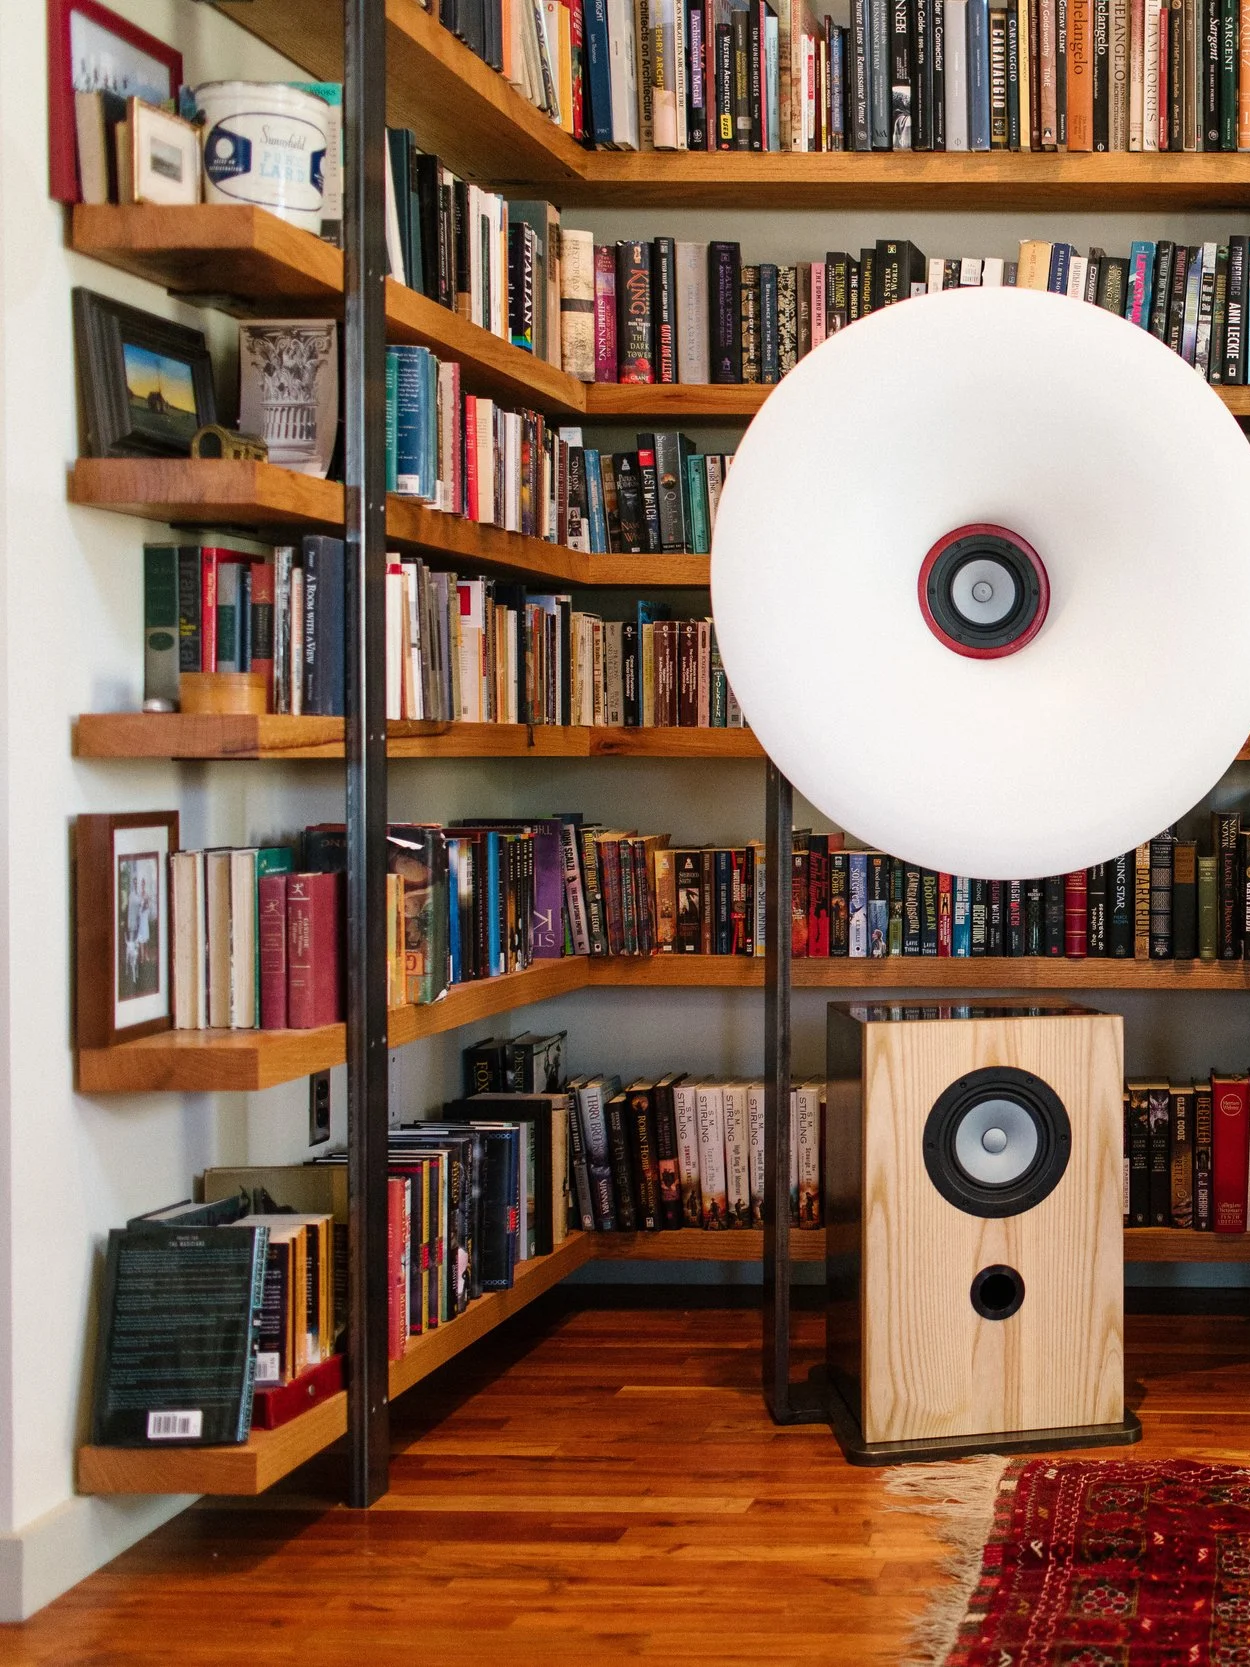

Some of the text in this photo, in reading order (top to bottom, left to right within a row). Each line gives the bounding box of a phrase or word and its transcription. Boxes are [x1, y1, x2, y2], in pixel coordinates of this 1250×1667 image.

[655, 24, 663, 53] GEHRY
[873, 2, 881, 48] RENAISSANCE
[918, 11, 926, 33] Calder
[1059, 0, 1067, 53] GUSTAV KLIMT
[1207, 18, 1222, 61] Sargent
[1225, 17, 1233, 73] SARGENT
[690, 14, 700, 104] Architectural Metals
[723, 36, 731, 68] WESTERN
[936, 27, 944, 71] Connecticut
[992, 29, 1006, 108] CARAVAGGIO
[1009, 20, 1018, 82] CARAVAGGIO
[1042, 10, 1052, 87] Goldsworthy TIME
[641, 60, 652, 121] Architecture
[856, 27, 866, 124] Lives Renaissance Venice
[1147, 59, 1158, 122] MORRIS
[524, 240, 532, 324] ITALIAN
[627, 268, 649, 315] KING
[834, 275, 846, 308] STRANGER
[850, 275, 858, 318] THE FOREVER
[862, 271, 874, 301] Windup
[1106, 264, 1115, 302] STRANGE
[1113, 265, 1122, 304] JONATHAN
[598, 301, 607, 360] STEPHEN KING
[1226, 302, 1241, 360] ANN LECKIE
[656, 435, 666, 474] Stephenson
[643, 468, 657, 521] LAST WATCH
[306, 584, 317, 611] ROOM
[306, 641, 316, 665] VIEW
[1221, 820, 1229, 848] NOVIK
[1228, 819, 1237, 849] NAOMI
[564, 847, 575, 872] SCALZI
[831, 869, 839, 894] HOBB
[922, 876, 937, 931] BOOKMAN
[1135, 867, 1150, 938] DARK RUN
[1224, 852, 1234, 944] LEAGUE DRAGONS
[591, 914, 600, 933] LECKIE
[972, 904, 985, 944] DECEPTIONS
[676, 1092, 688, 1140] STIRLING
[699, 1095, 710, 1143] STIRLING
[725, 1094, 736, 1142] STIRLING
[749, 1098, 760, 1146] STIRLING
[798, 1096, 808, 1144] STIRLING
[1176, 1096, 1186, 1141] GLEN COOK
[1197, 1097, 1211, 1144] DECEIVER
[637, 1114, 650, 1170] ROBIN HOBB
[598, 1178, 610, 1215] SHANNARA
